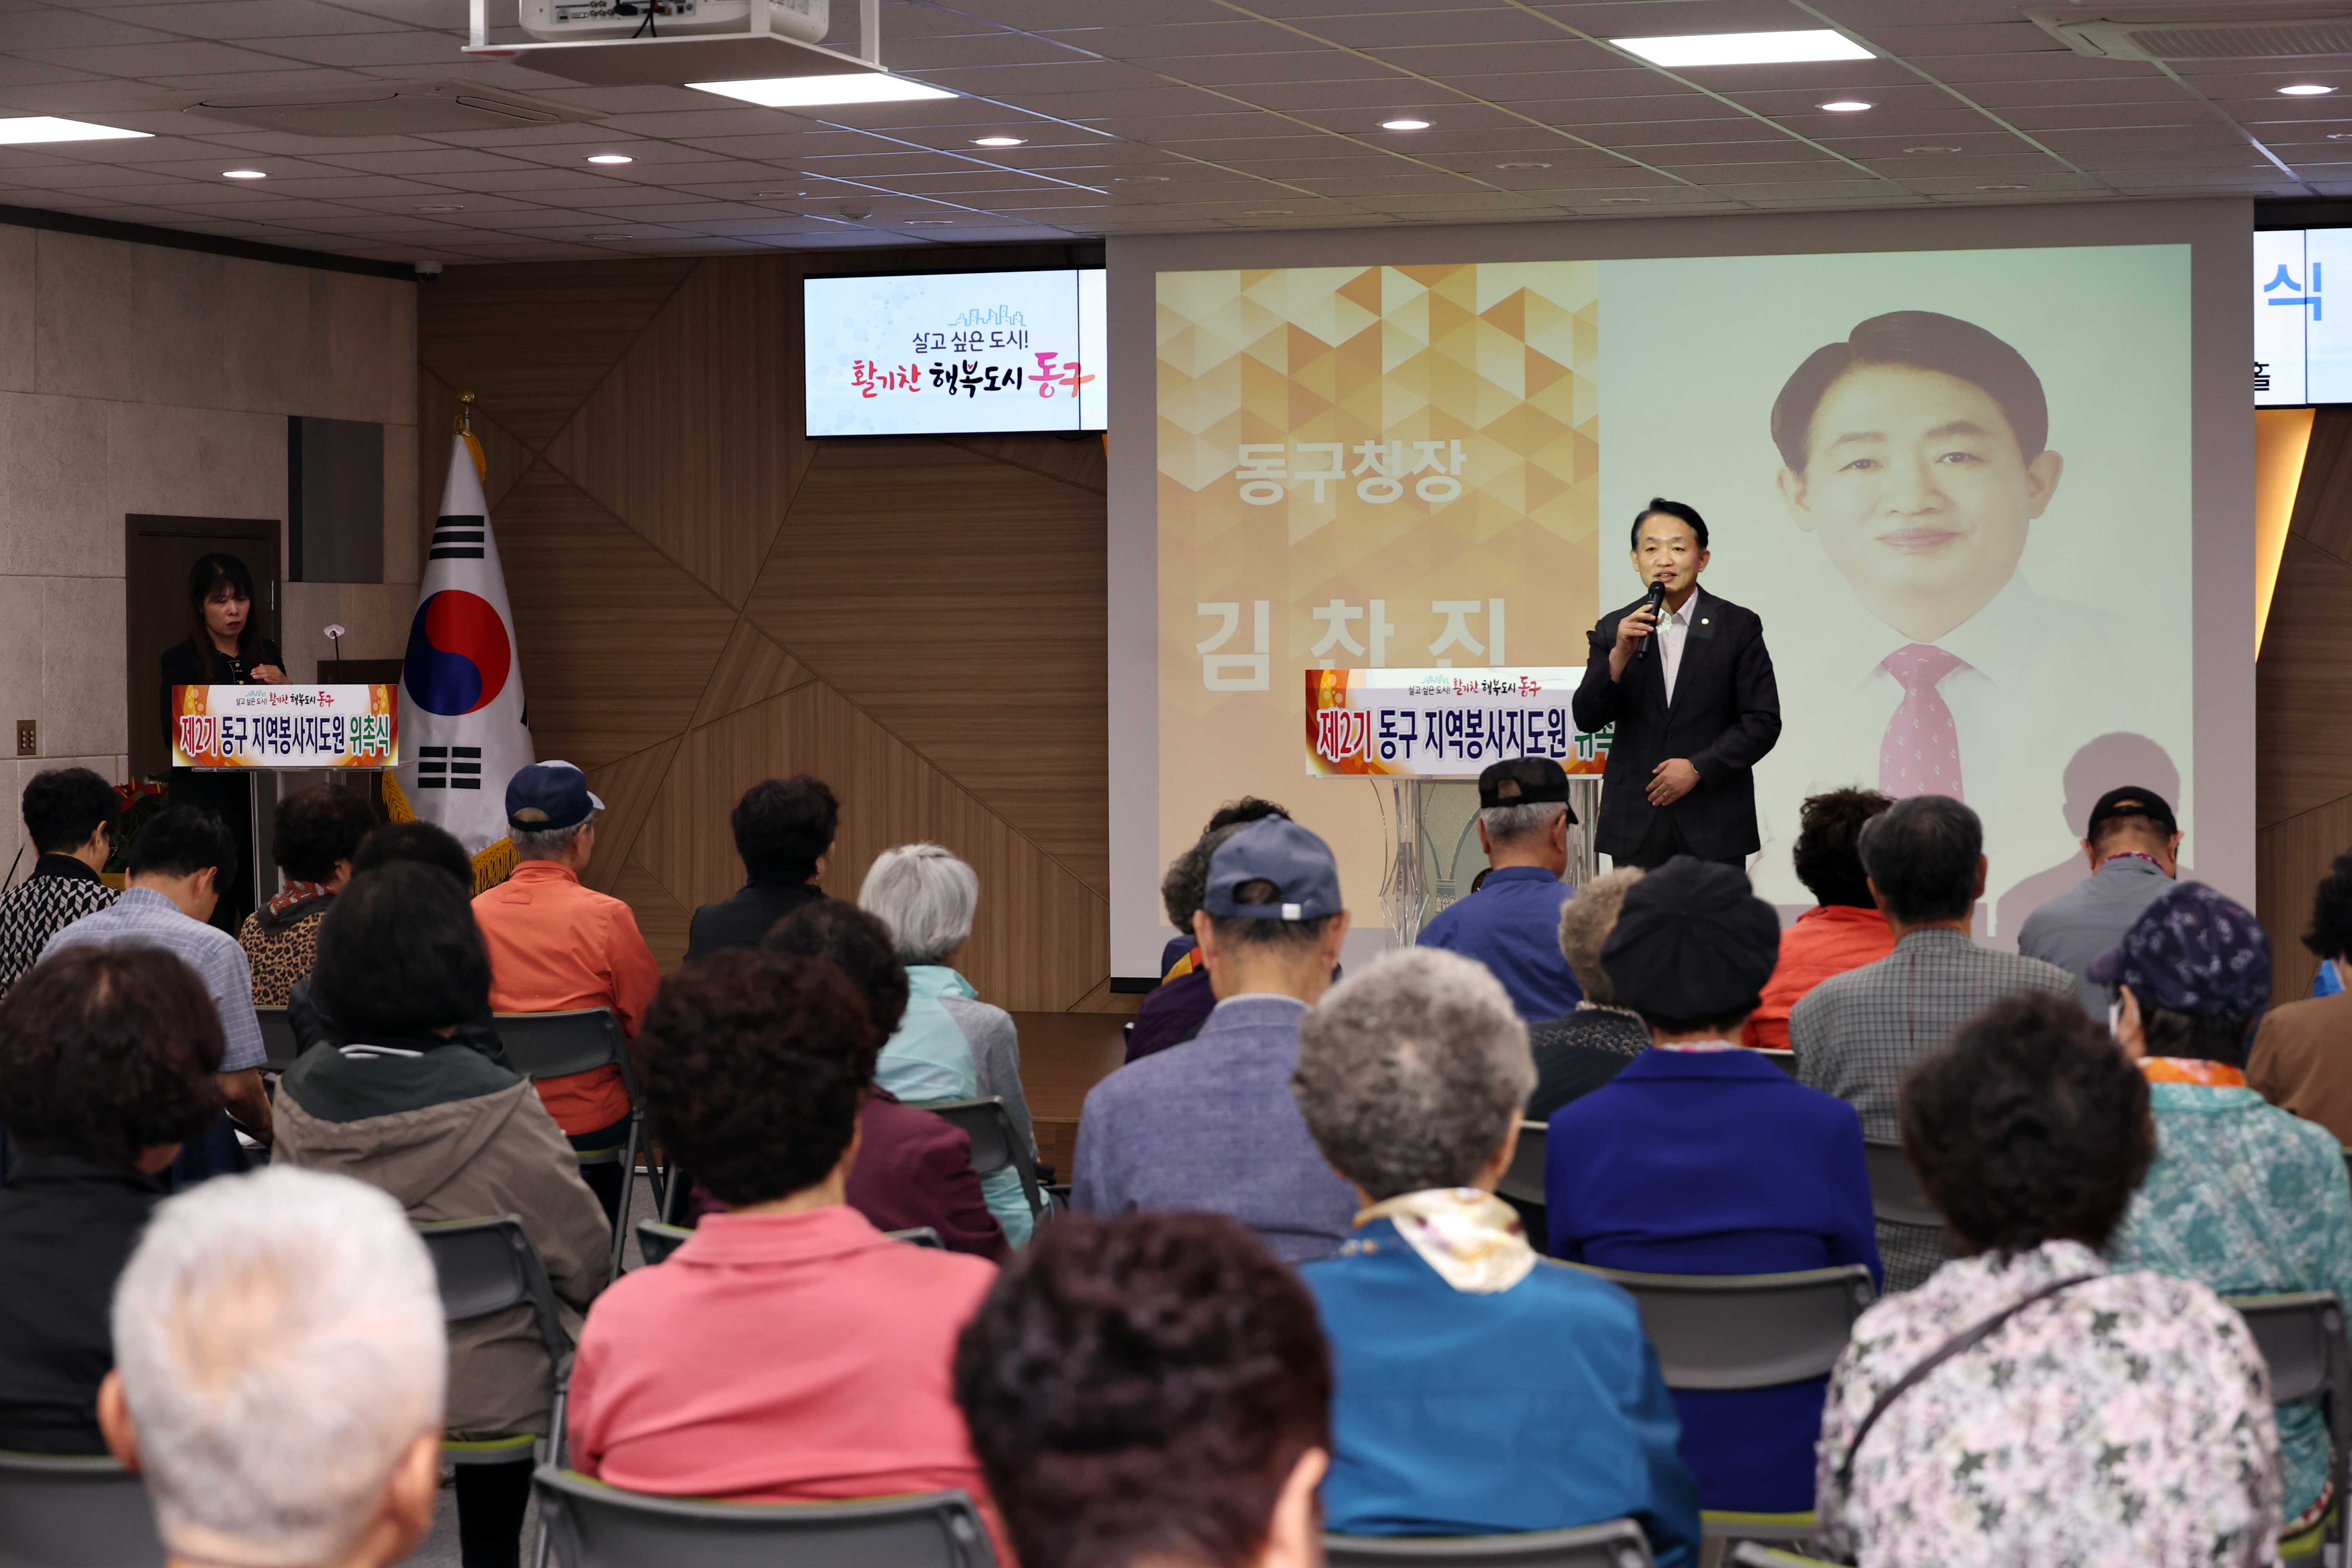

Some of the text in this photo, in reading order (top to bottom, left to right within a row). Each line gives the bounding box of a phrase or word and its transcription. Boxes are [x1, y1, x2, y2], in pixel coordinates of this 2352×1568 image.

[2263, 262, 2321, 321] 식
[913, 330, 1028, 354] 살고 싶은 도시!
[851, 352, 1095, 398] 활기찬 행복도시 동구
[1235, 439, 1467, 505] 동구청장
[269, 692, 288, 706] 활기찬
[290, 693, 316, 706] 행복도시
[317, 691, 334, 707] 동구
[1408, 676, 1542, 697] 살고 싶은 도시! 활기찬 행복도시 동구
[182, 715, 389, 755] 제2기 동구 지역봉사지도원 위촉식
[1319, 710, 1371, 759] 제2기
[1379, 710, 1418, 759] 동구
[1425, 708, 1566, 759] 지역봉사지도원
